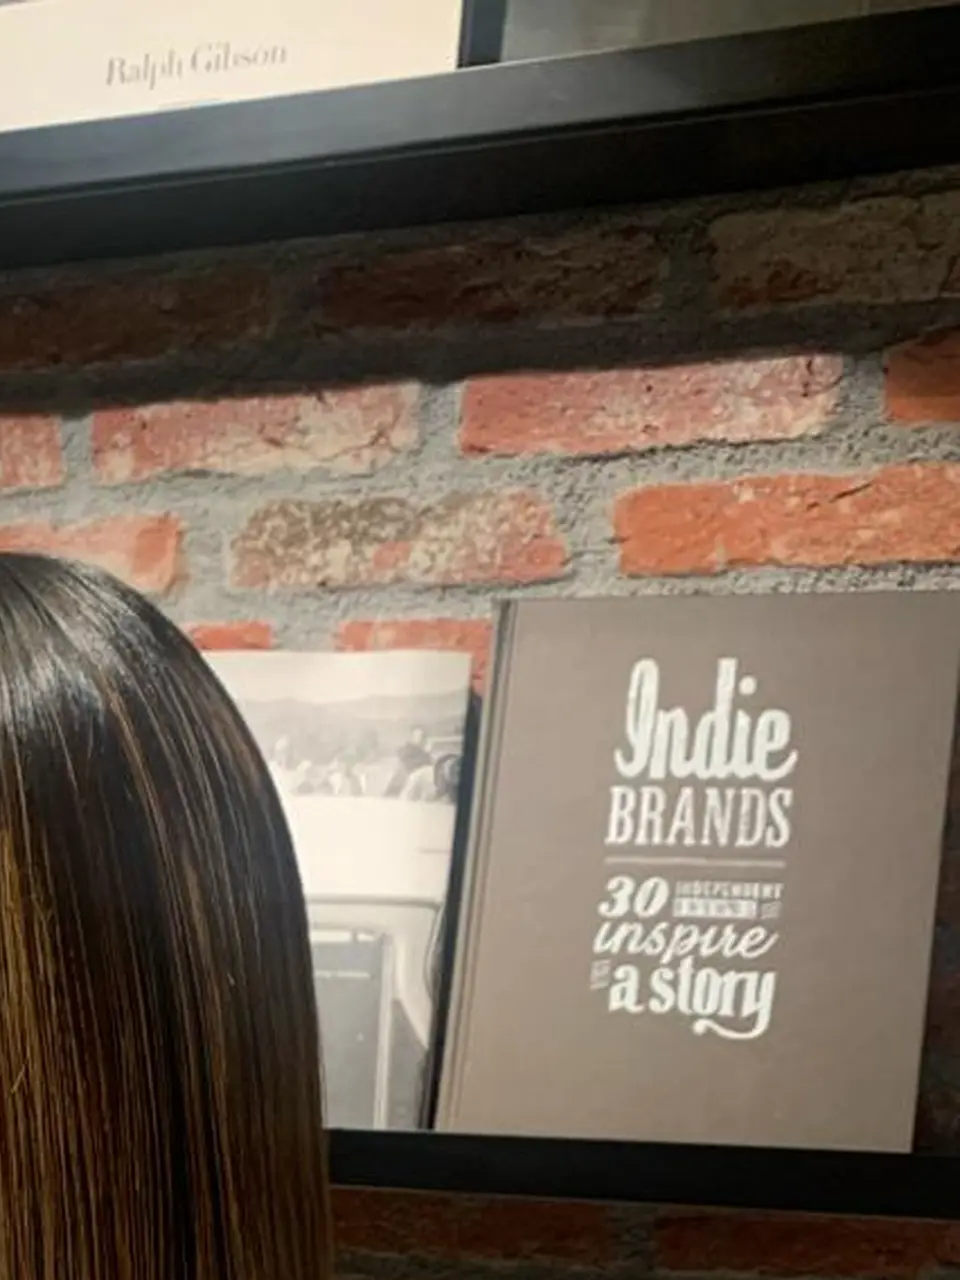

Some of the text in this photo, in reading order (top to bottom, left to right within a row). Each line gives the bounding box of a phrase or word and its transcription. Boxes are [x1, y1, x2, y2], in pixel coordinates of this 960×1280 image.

[105, 41, 287, 91] Ralph Gibson
[613, 657, 799, 780] Indie
[604, 786, 794, 849] BRANDS
[597, 875, 670, 918] 30
[592, 920, 781, 966] inspire
[608, 963, 645, 1013] a
[648, 955, 777, 1040] story
